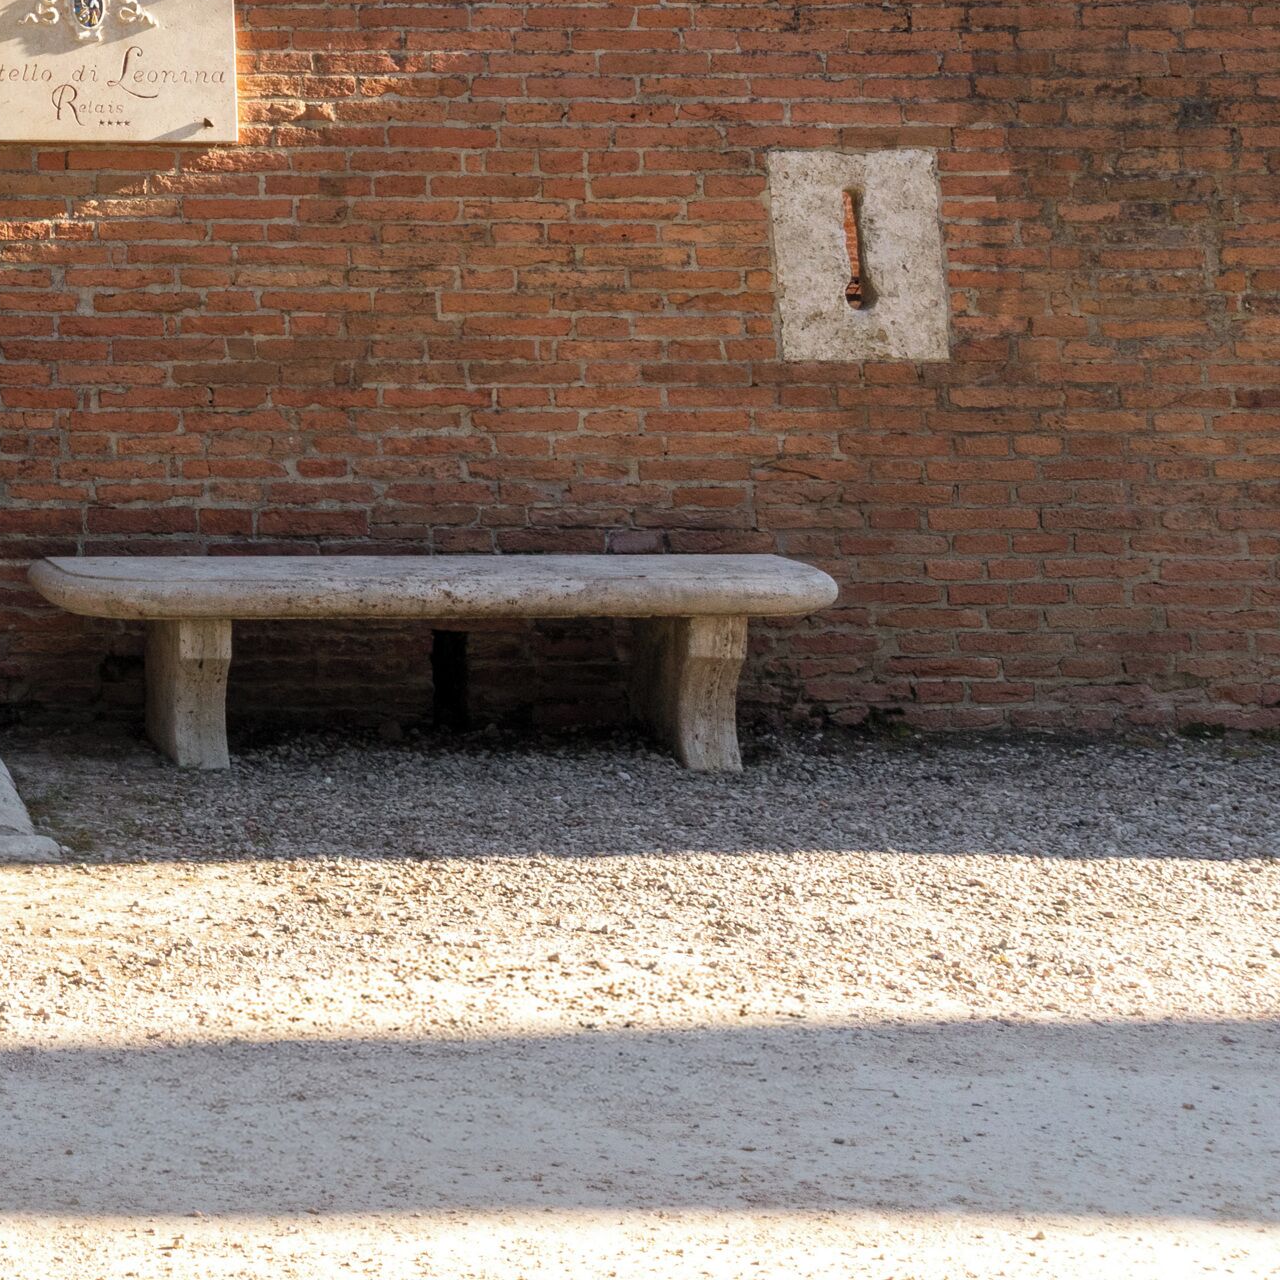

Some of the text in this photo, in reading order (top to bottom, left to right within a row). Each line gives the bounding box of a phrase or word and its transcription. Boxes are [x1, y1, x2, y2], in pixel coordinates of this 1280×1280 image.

[71, 64, 99, 82] di
[106, 45, 226, 99] Leonina
[51, 83, 125, 127] Relais
